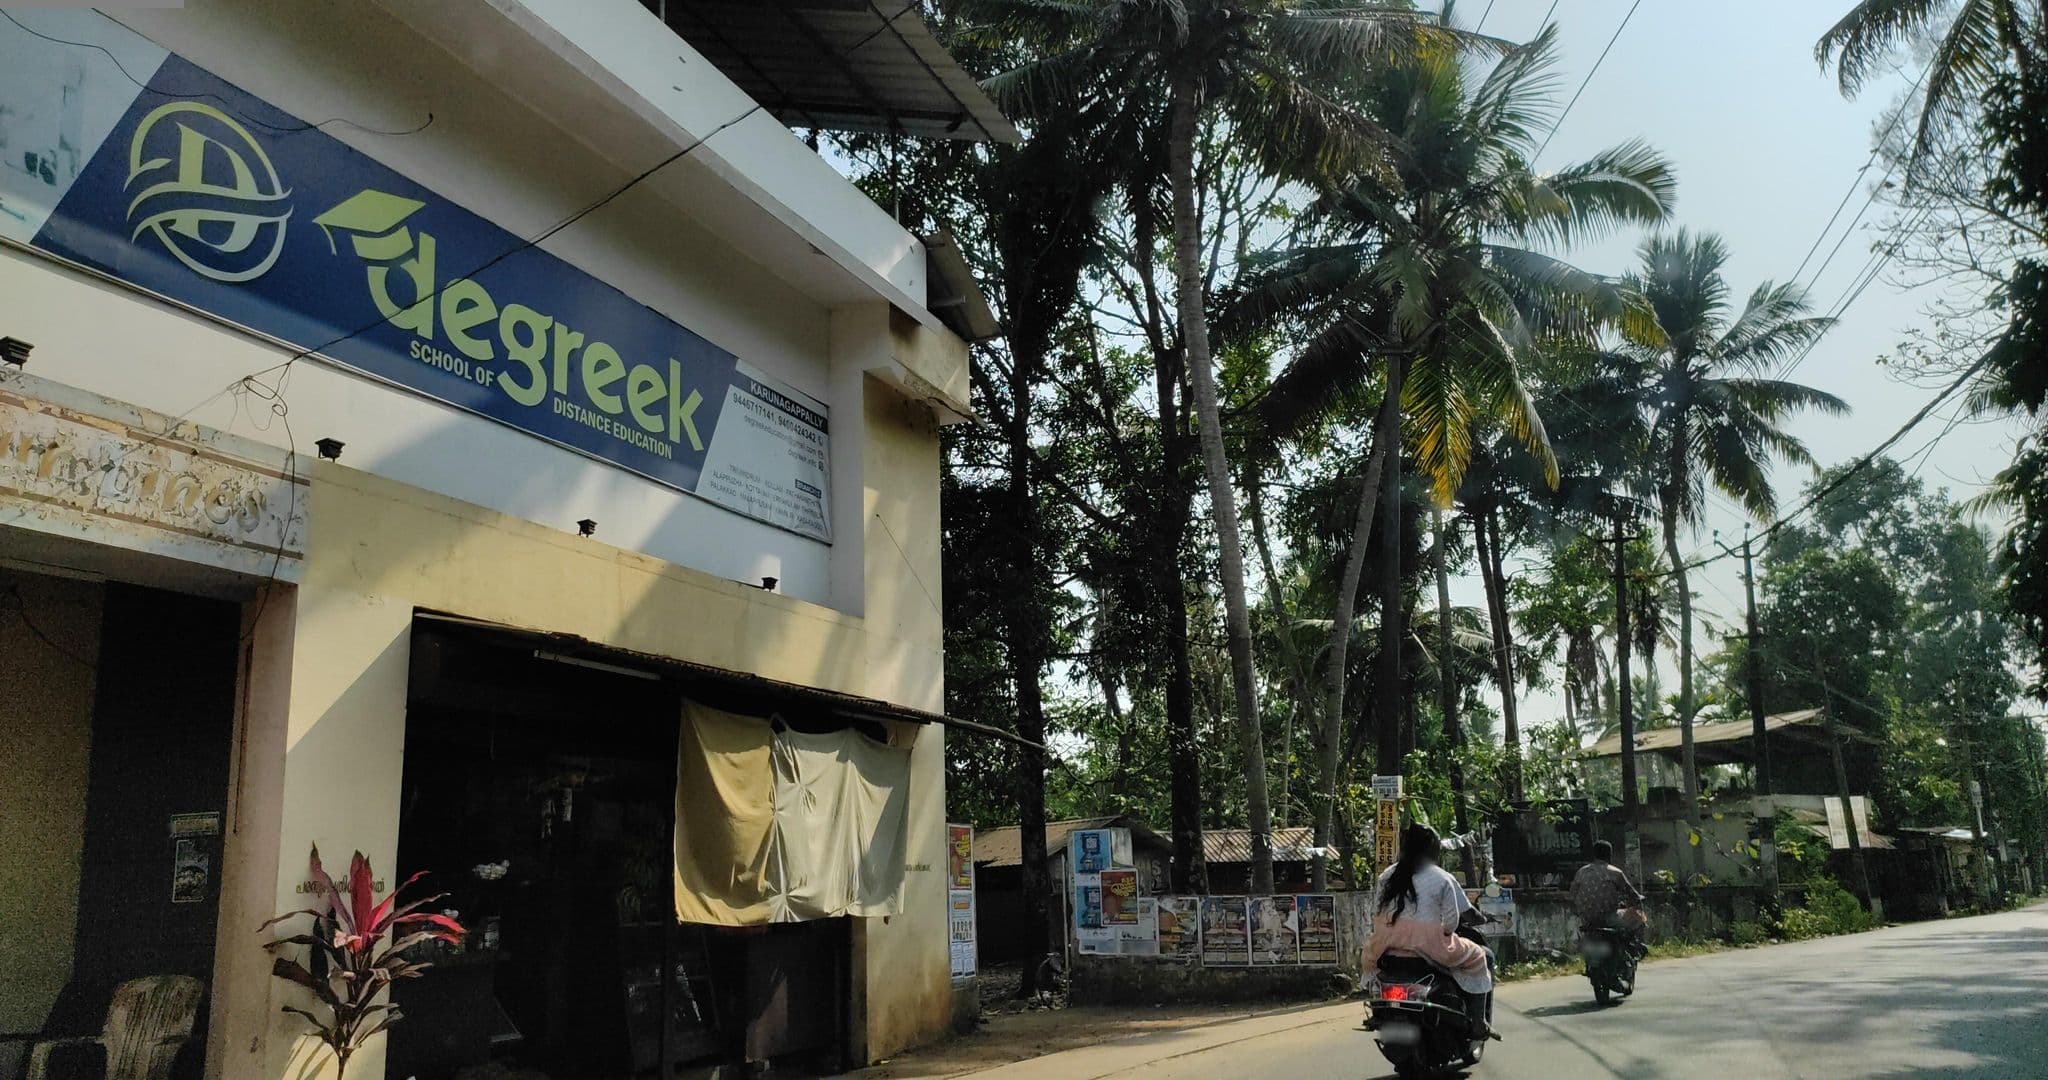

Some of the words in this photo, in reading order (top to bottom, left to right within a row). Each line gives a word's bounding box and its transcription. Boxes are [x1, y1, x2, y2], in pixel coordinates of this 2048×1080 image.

[366, 231, 704, 452] degreek
[410, 340, 473, 380] SCHOOL
[475, 366, 495, 387] OF
[554, 396, 611, 435] DISTANCE
[613, 421, 672, 460] EDUCATION
[750, 381, 824, 428] KARUNAGAPPALLY
